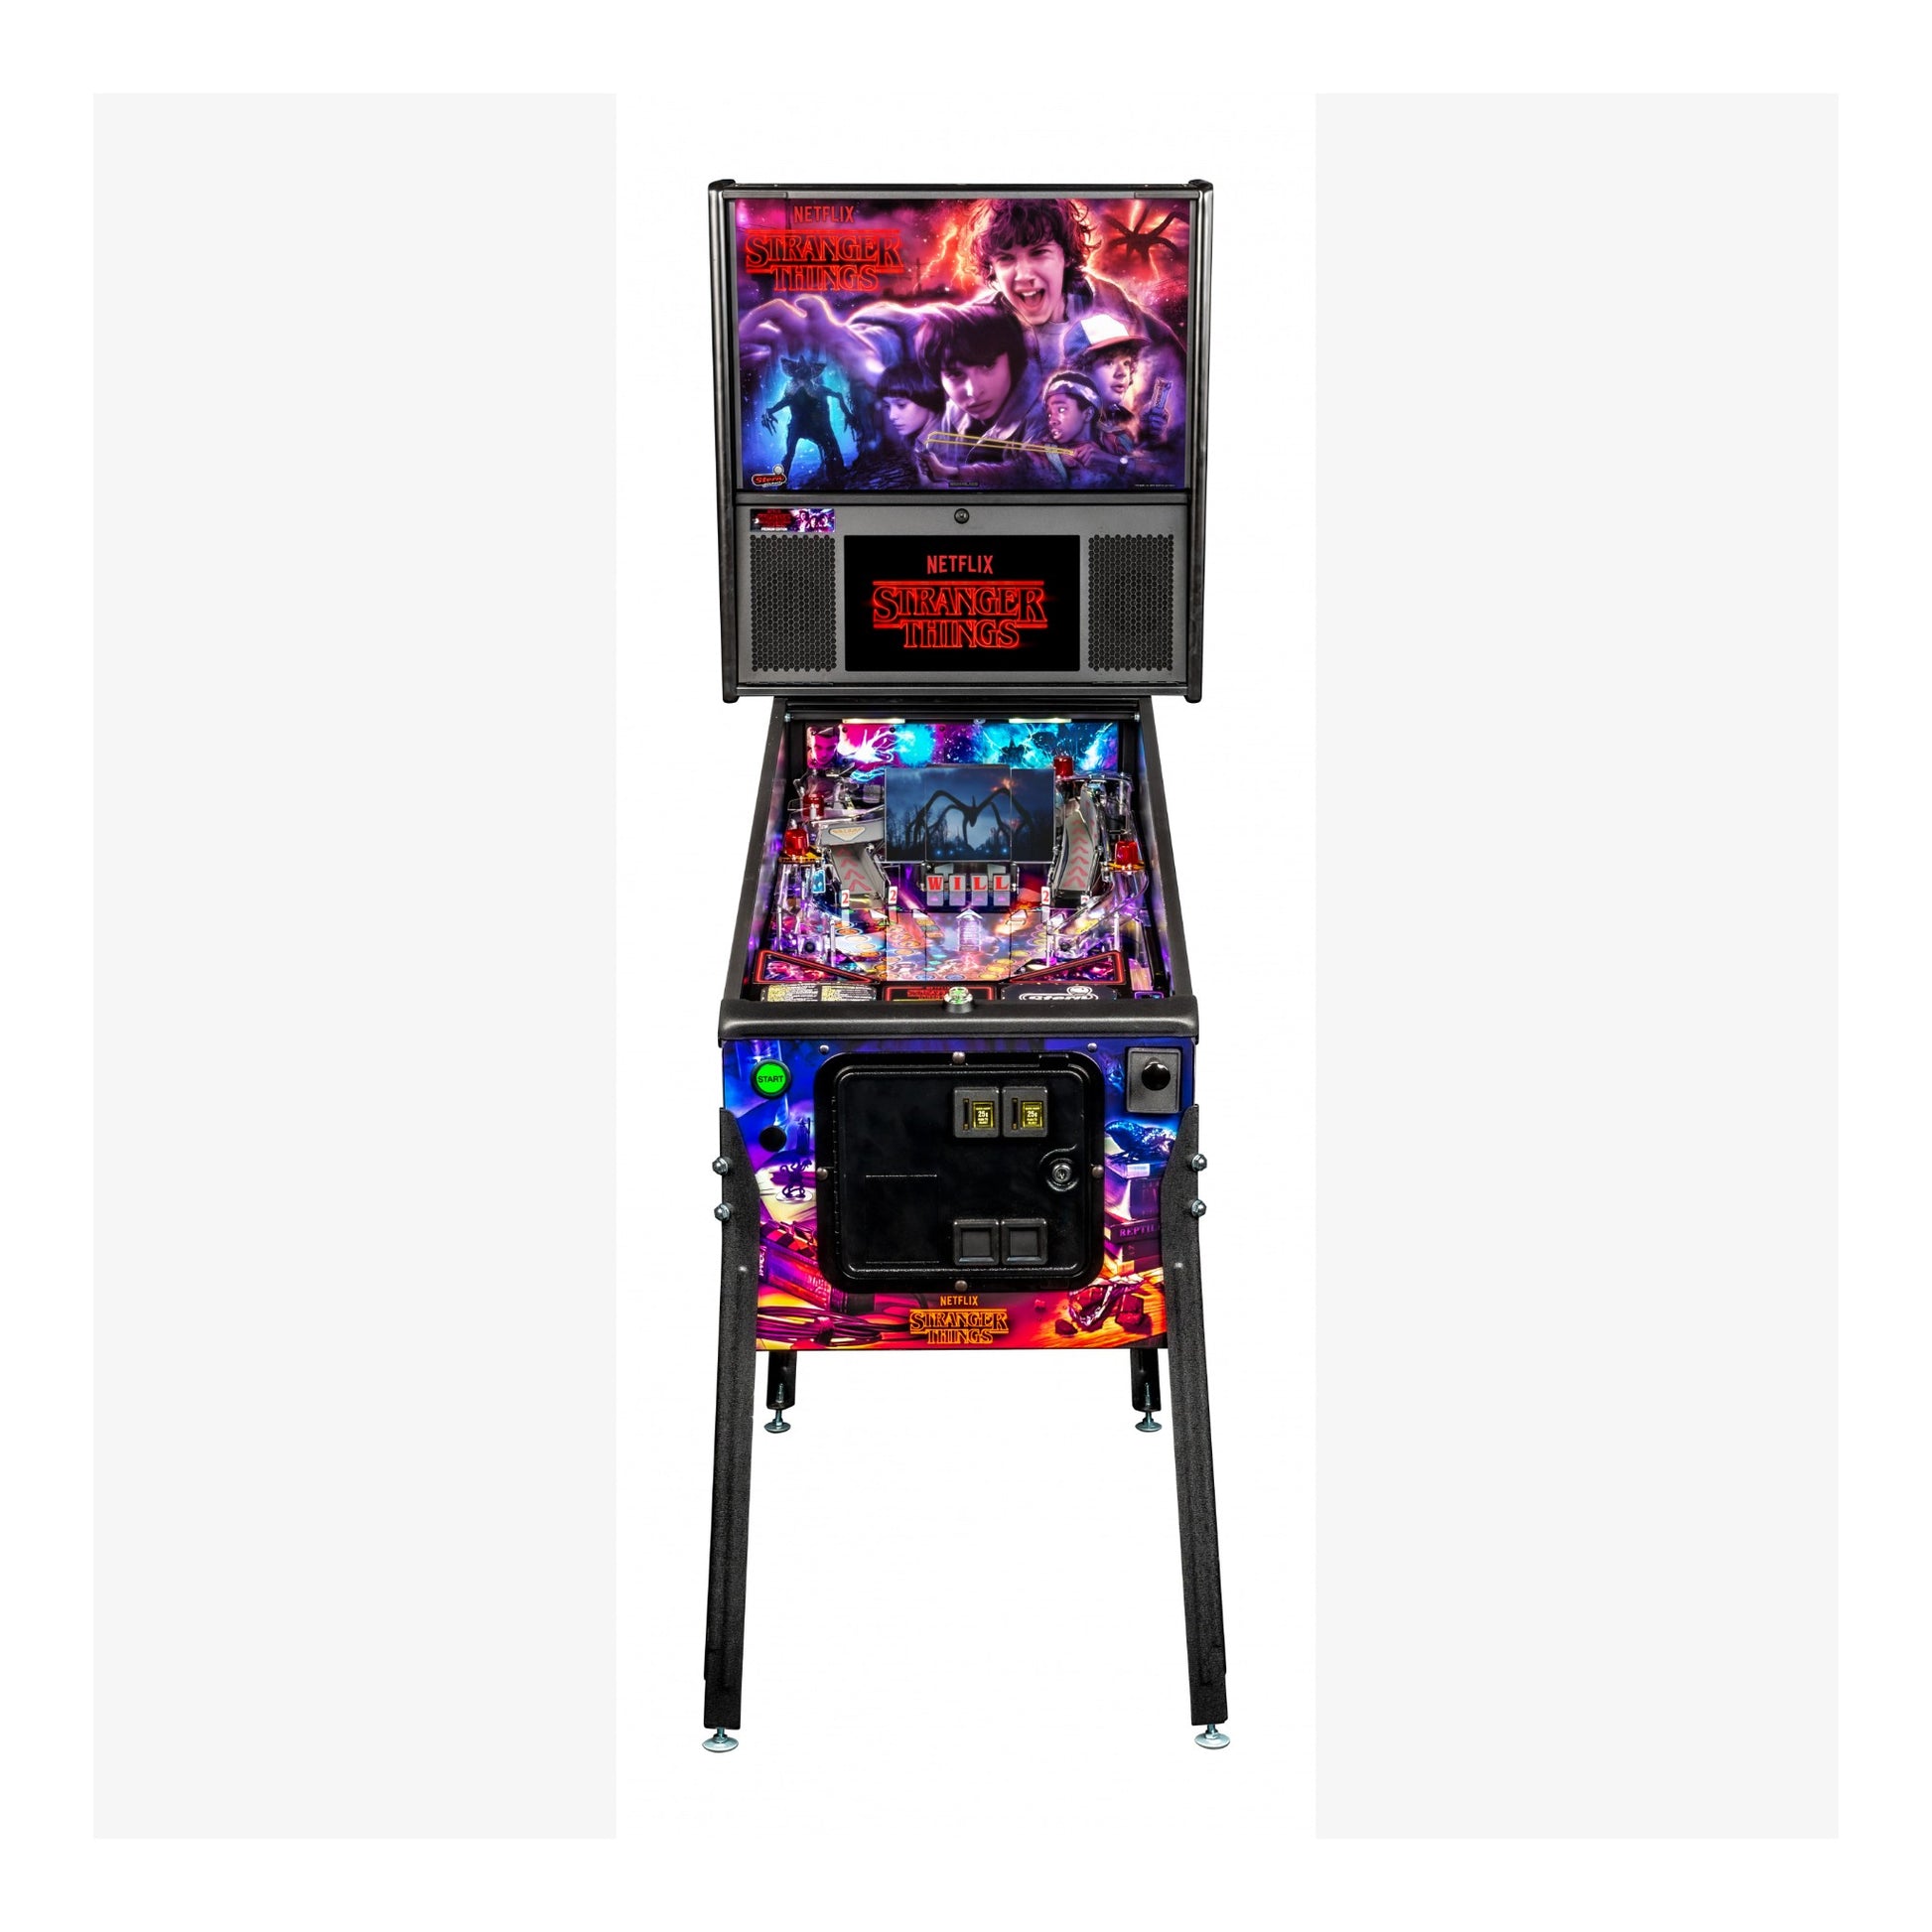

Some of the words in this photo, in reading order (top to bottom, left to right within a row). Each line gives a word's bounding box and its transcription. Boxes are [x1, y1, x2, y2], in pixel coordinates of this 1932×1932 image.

[794, 206, 855, 223] NETFLIX
[746, 233, 903, 268] STRANGER
[771, 264, 880, 292] THINGS
[926, 555, 993, 574] NETFLIX
[873, 586, 1048, 622] STRANGER
[899, 619, 1021, 648] THINGS
[939, 1296, 978, 1307] NETFLIX
[909, 1311, 1010, 1331] STRANGER
[926, 1328, 994, 1344] THINGS
